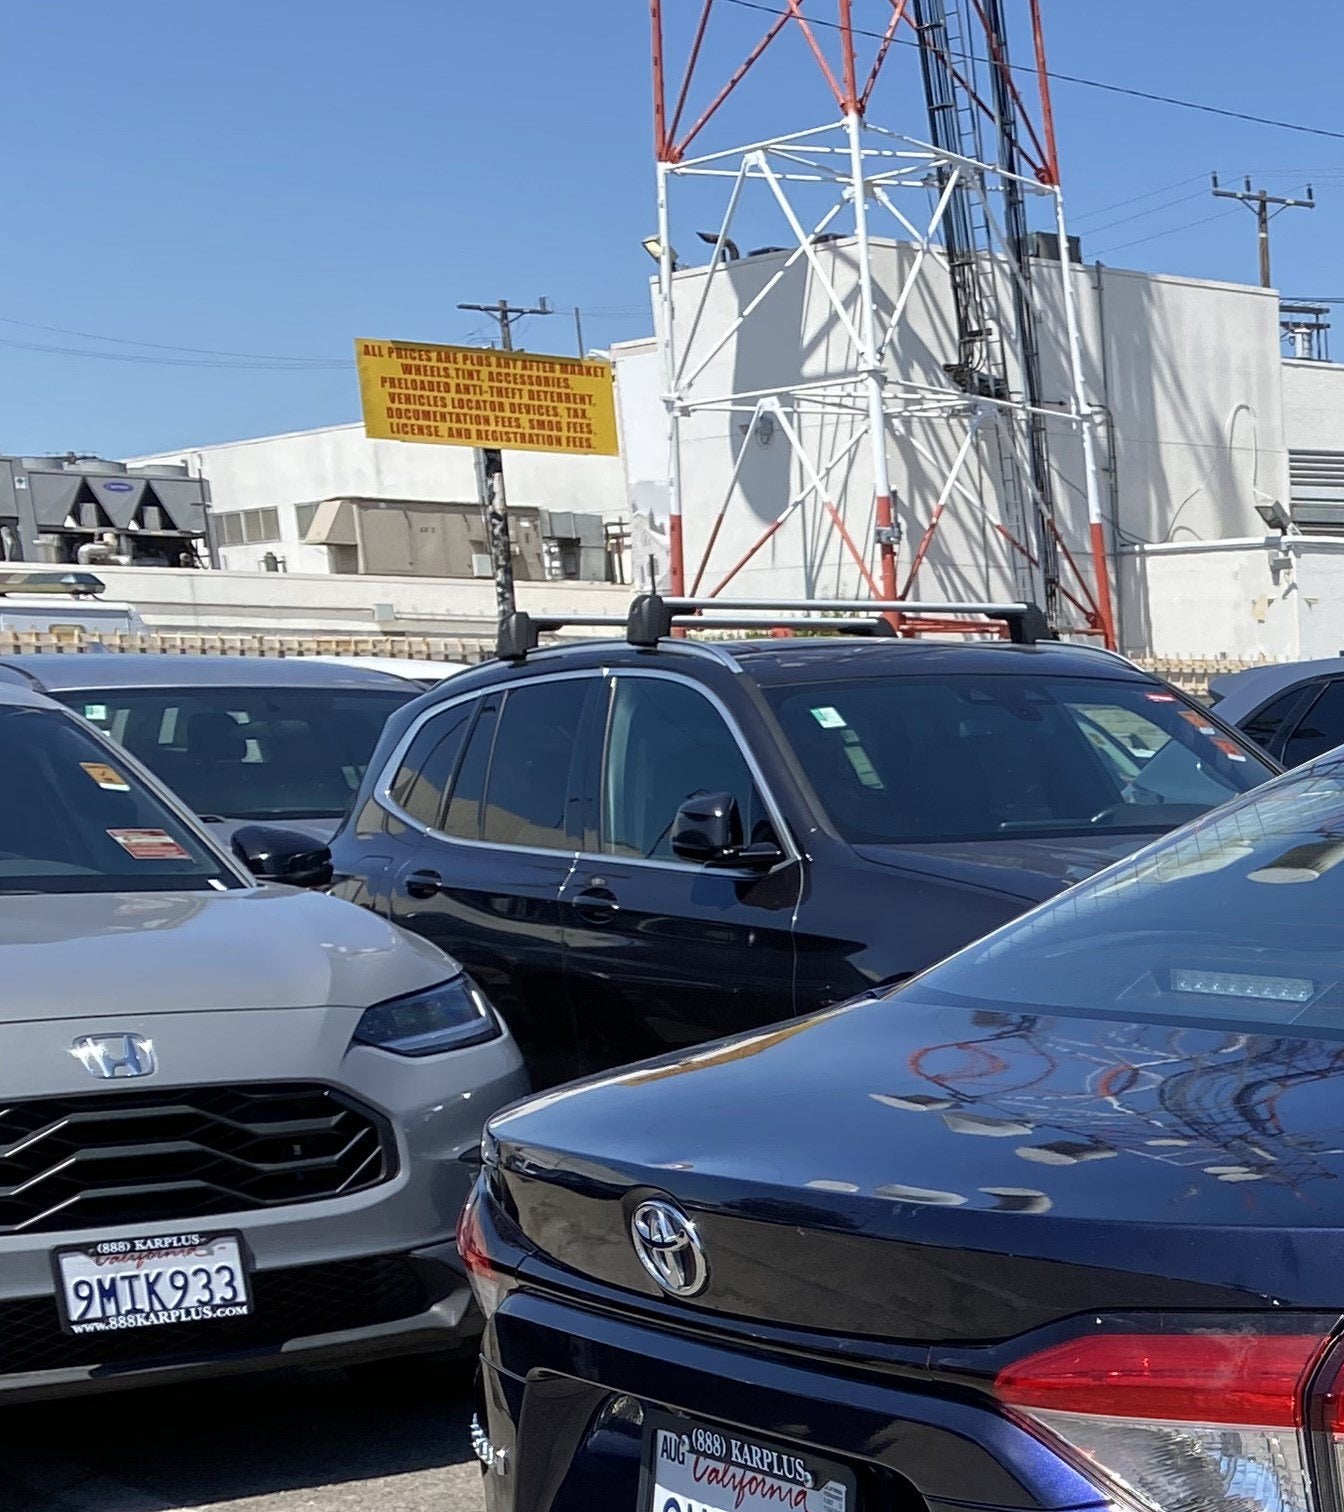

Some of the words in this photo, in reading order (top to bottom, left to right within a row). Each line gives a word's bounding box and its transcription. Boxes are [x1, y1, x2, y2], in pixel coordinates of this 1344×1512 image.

[363, 344, 384, 358] ALL
[388, 346, 432, 363] PRICES
[436, 350, 459, 366] ARE
[463, 353, 491, 368] PLUS
[495, 357, 519, 371] ANY
[521, 359, 556, 374] AFTER
[560, 360, 606, 379] MARKET
[380, 376, 451, 395] PRELOADED
[455, 383, 524, 400] ANTI-THEFT
[388, 391, 448, 410] VEHICLES
[451, 397, 506, 414] LOCATOR
[386, 406, 491, 427] DOCUMENTATION
[528, 418, 563, 433] SMOG
[447, 425, 472, 440] AND
[476, 429, 562, 448] REGISTRATION
[96, 1242, 131, 1255] (888)
[134, 1233, 200, 1251] KARPLUS
[72, 1264, 238, 1321] 9MIK933
[660, 1434, 687, 1466] AUG
[691, 1427, 727, 1458] (888)
[729, 1438, 806, 1482] KARPLUS
